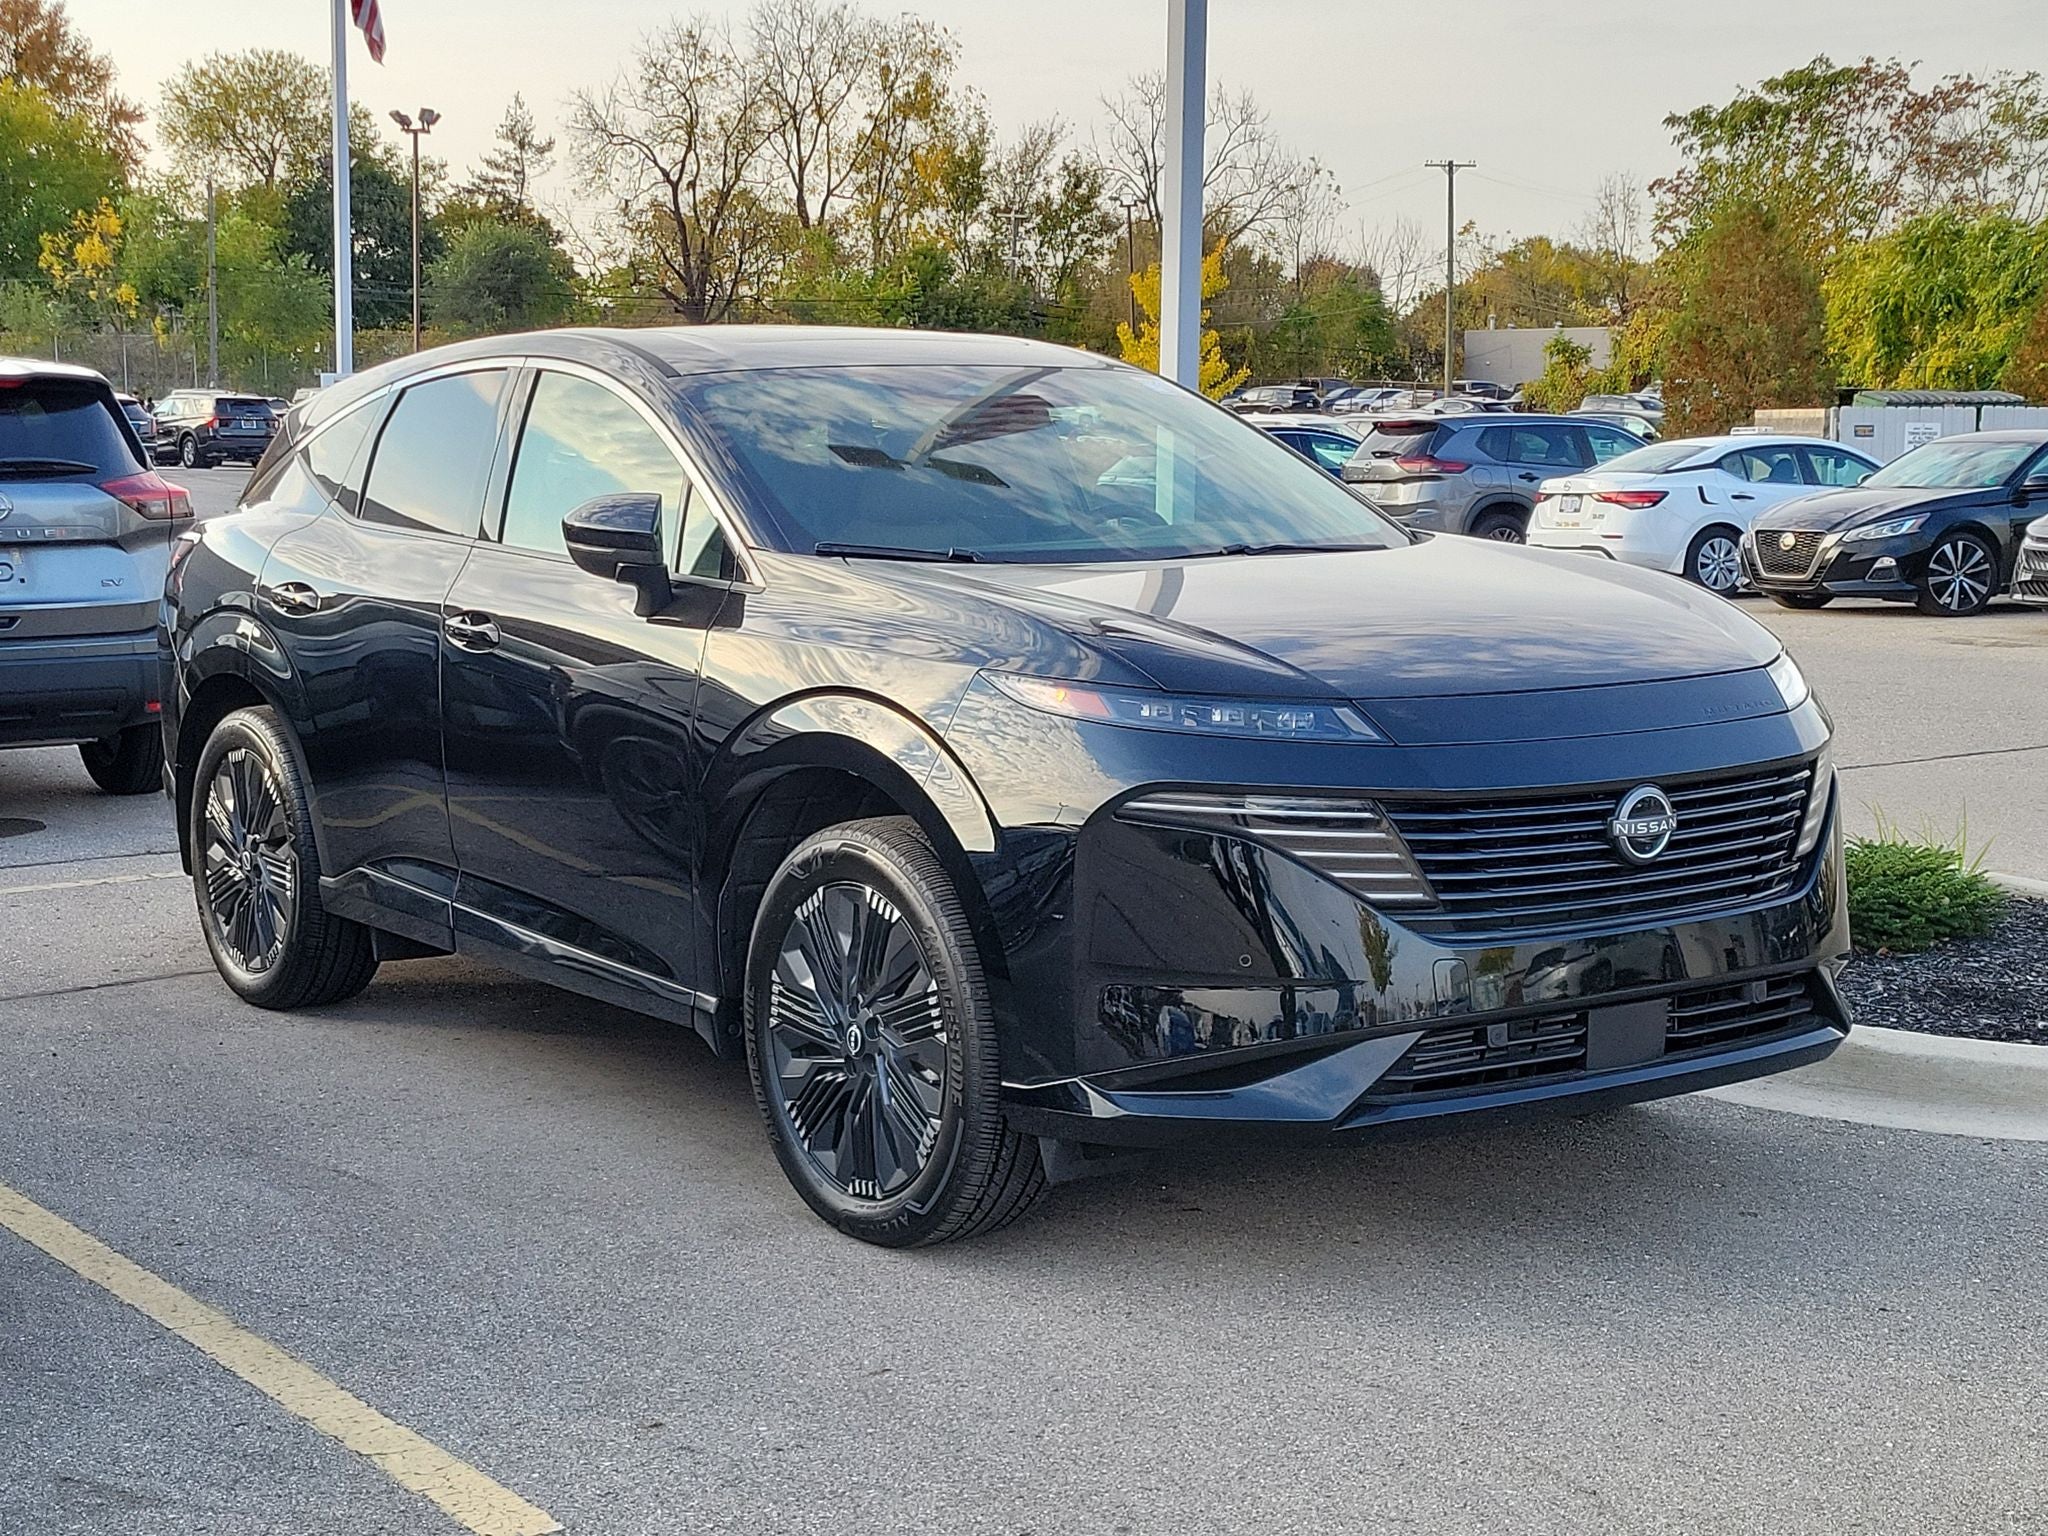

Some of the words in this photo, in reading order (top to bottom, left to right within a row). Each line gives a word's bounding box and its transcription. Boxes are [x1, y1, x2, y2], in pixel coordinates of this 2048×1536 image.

[101, 578, 124, 587] SV
[1616, 816, 1677, 834] NISSAN
[922, 926, 964, 1107] BRIDGESTONE
